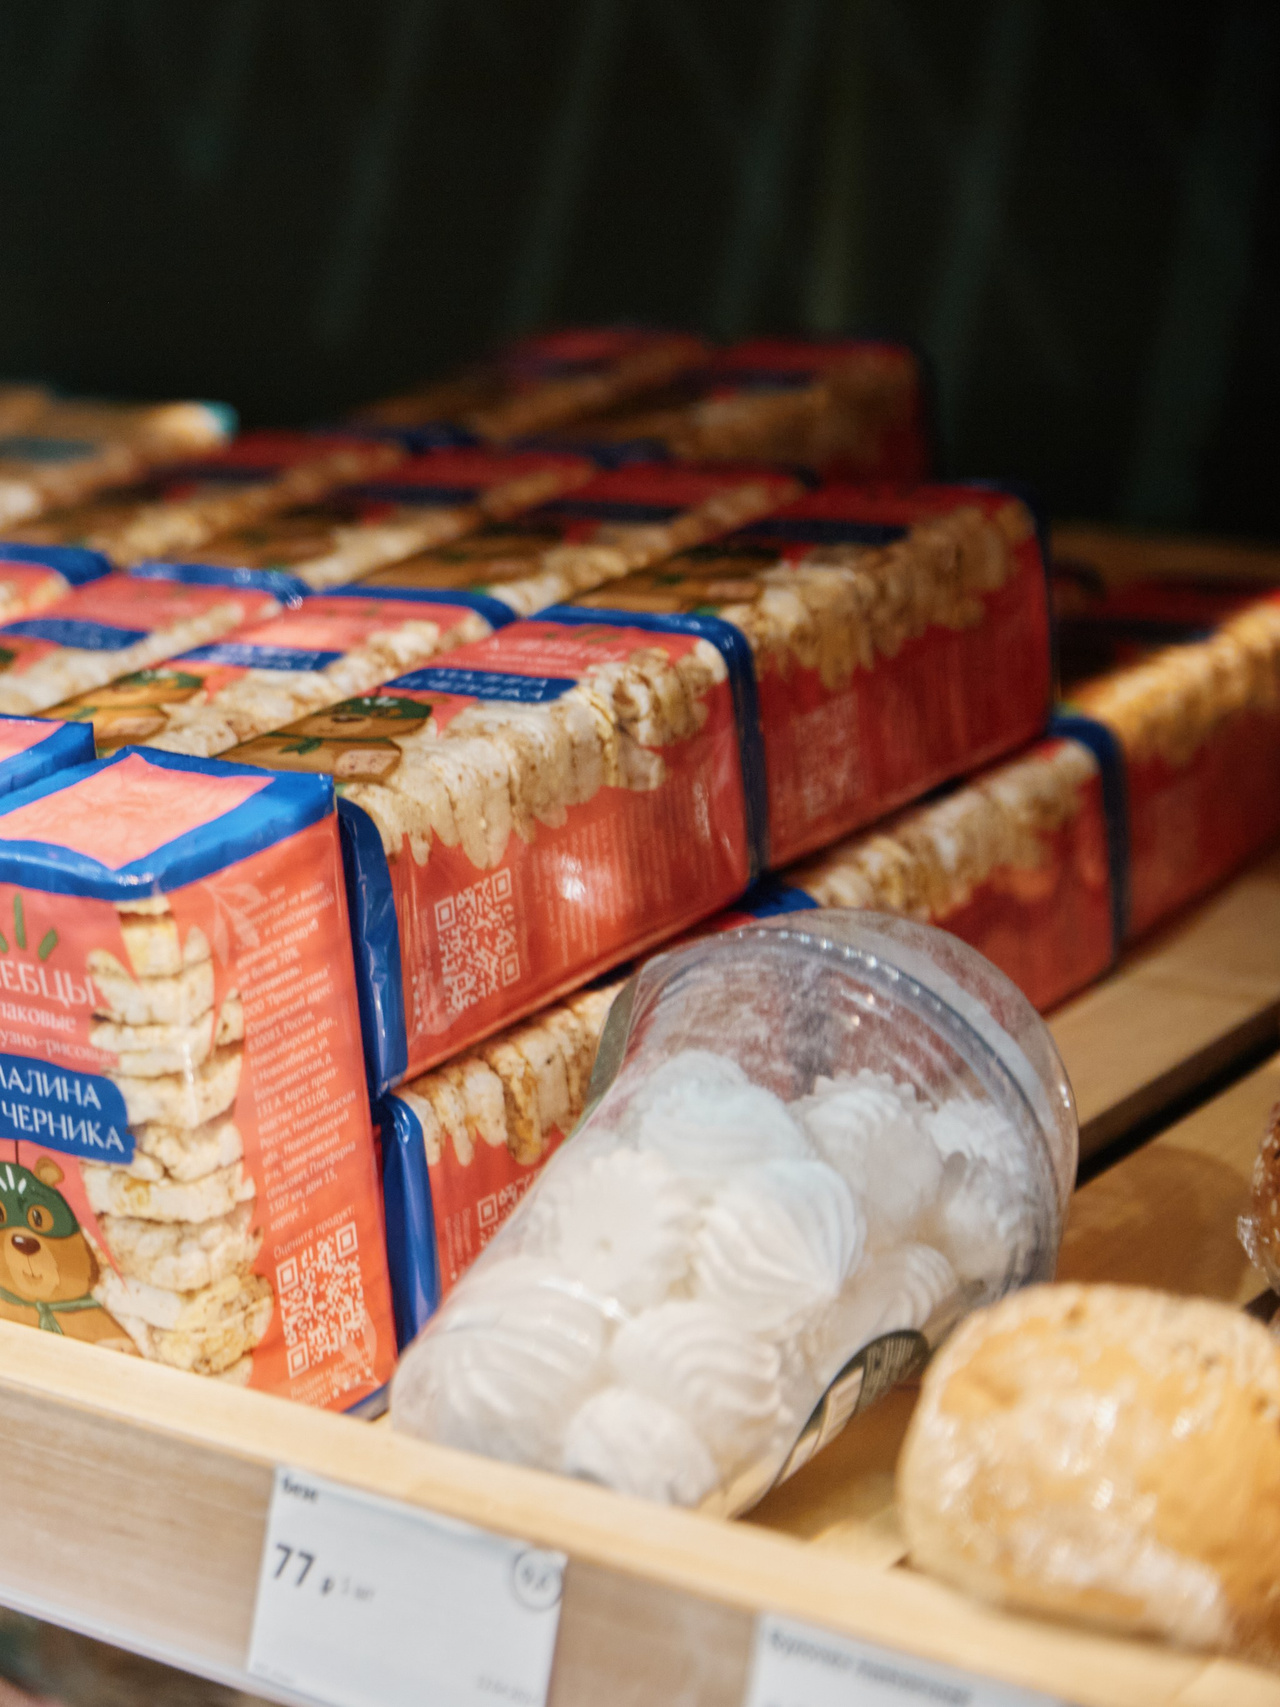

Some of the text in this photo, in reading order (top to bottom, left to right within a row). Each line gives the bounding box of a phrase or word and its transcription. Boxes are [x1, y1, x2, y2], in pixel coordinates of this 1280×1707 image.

[1, 1099, 125, 1153] ЧЕРНИКА
[273, 1230, 314, 1260] Оцените
[274, 1542, 316, 1588] 77
